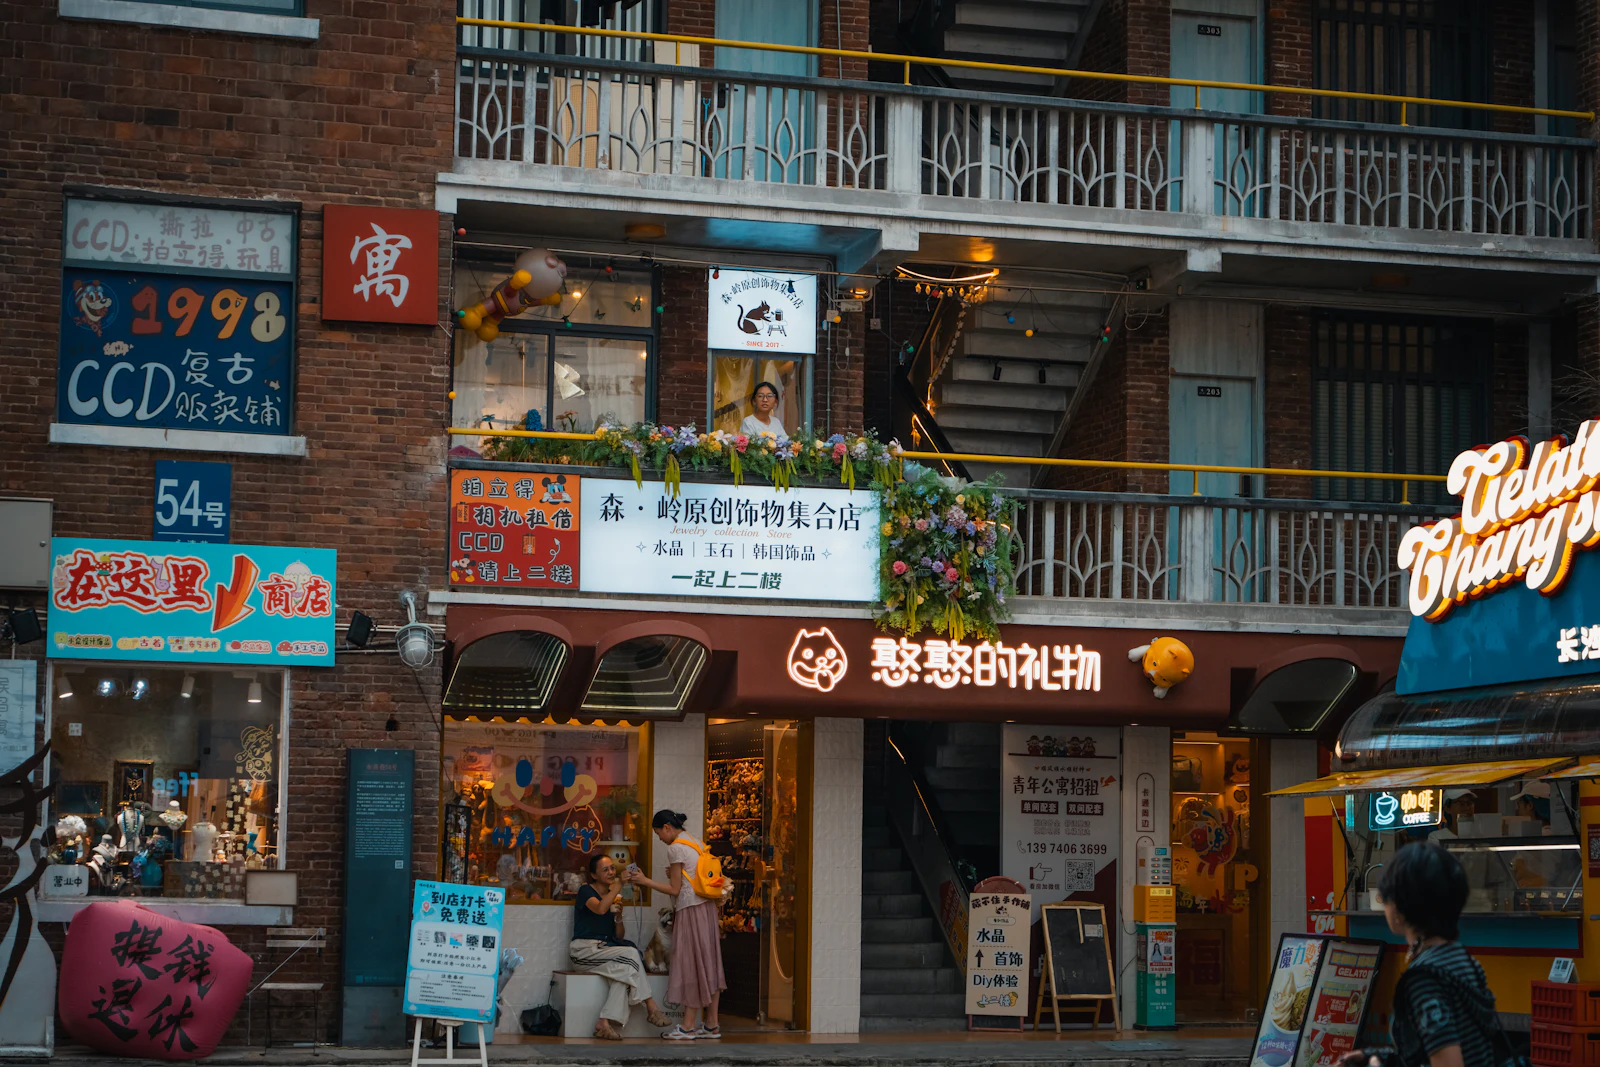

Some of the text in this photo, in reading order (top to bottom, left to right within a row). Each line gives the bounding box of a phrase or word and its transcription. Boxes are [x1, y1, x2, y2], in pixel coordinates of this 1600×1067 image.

[1206, 26, 1220, 35] 303
[72, 218, 130, 253] CCD
[236, 213, 277, 244] 中古
[142, 238, 283, 273] 拍立得 玩具
[349, 222, 413, 309] 寓
[131, 286, 286, 342] 1998
[180, 348, 255, 388] 复古
[67, 359, 176, 421] CCD
[1206, 388, 1220, 396] 203
[175, 390, 282, 427] 贩卖铺
[461, 476, 534, 500] 拍立得
[155, 478, 227, 529] 54号
[473, 505, 573, 530] 相机租借
[458, 532, 505, 552] CCD
[670, 524, 793, 539] Jewelry collection Store
[653, 539, 816, 561] 水晶 玉石 韩国饰品
[1398, 491, 1600, 617] Changs
[57, 551, 331, 617] 在这里 商店
[478, 560, 573, 585] 请上二楼
[671, 568, 783, 591] 一起上二楼
[871, 637, 1101, 692] 憨憨的礼物
[1013, 775, 1100, 797] 青年公寓招租
[1402, 811, 1430, 825] COFFEE
[491, 825, 595, 853] HAPPY
[1027, 842, 1107, 856] 139 7406 3699
[53, 875, 83, 888] 营业中
[431, 891, 486, 909] 到店打卡
[441, 907, 488, 926] 免费送
[976, 928, 1005, 944] 水晶
[994, 951, 1023, 967] 首饰
[973, 974, 1020, 989] Diy体验
[1338, 967, 1367, 980] GELATO
[88, 977, 199, 1053] 退休
